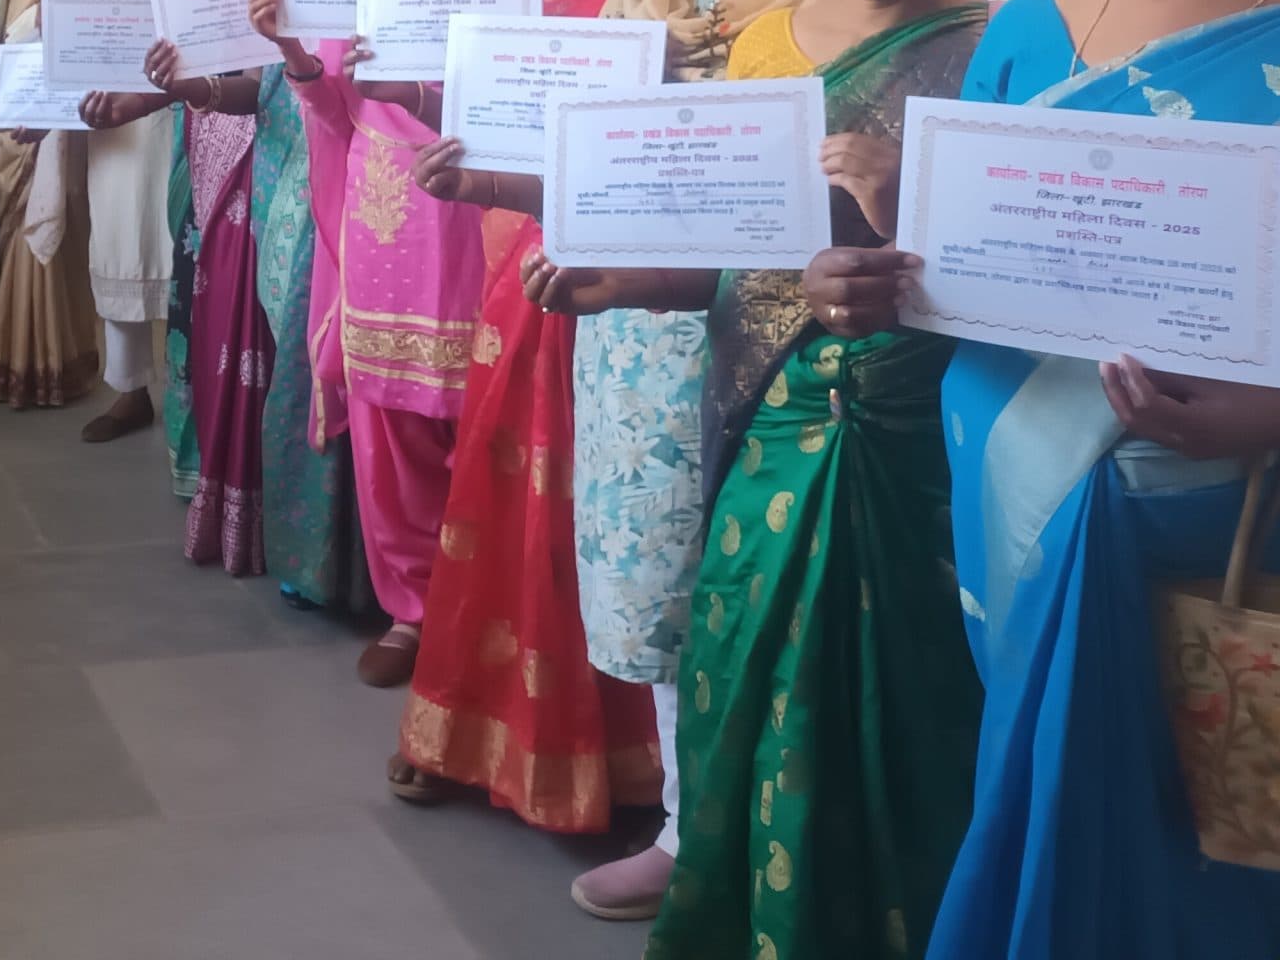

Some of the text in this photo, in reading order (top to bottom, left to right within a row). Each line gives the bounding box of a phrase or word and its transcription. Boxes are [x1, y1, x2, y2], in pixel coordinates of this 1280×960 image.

[1062, 209, 1104, 225] महिला
[1109, 214, 1145, 229] दिवस
[1163, 223, 1200, 235] 2025
